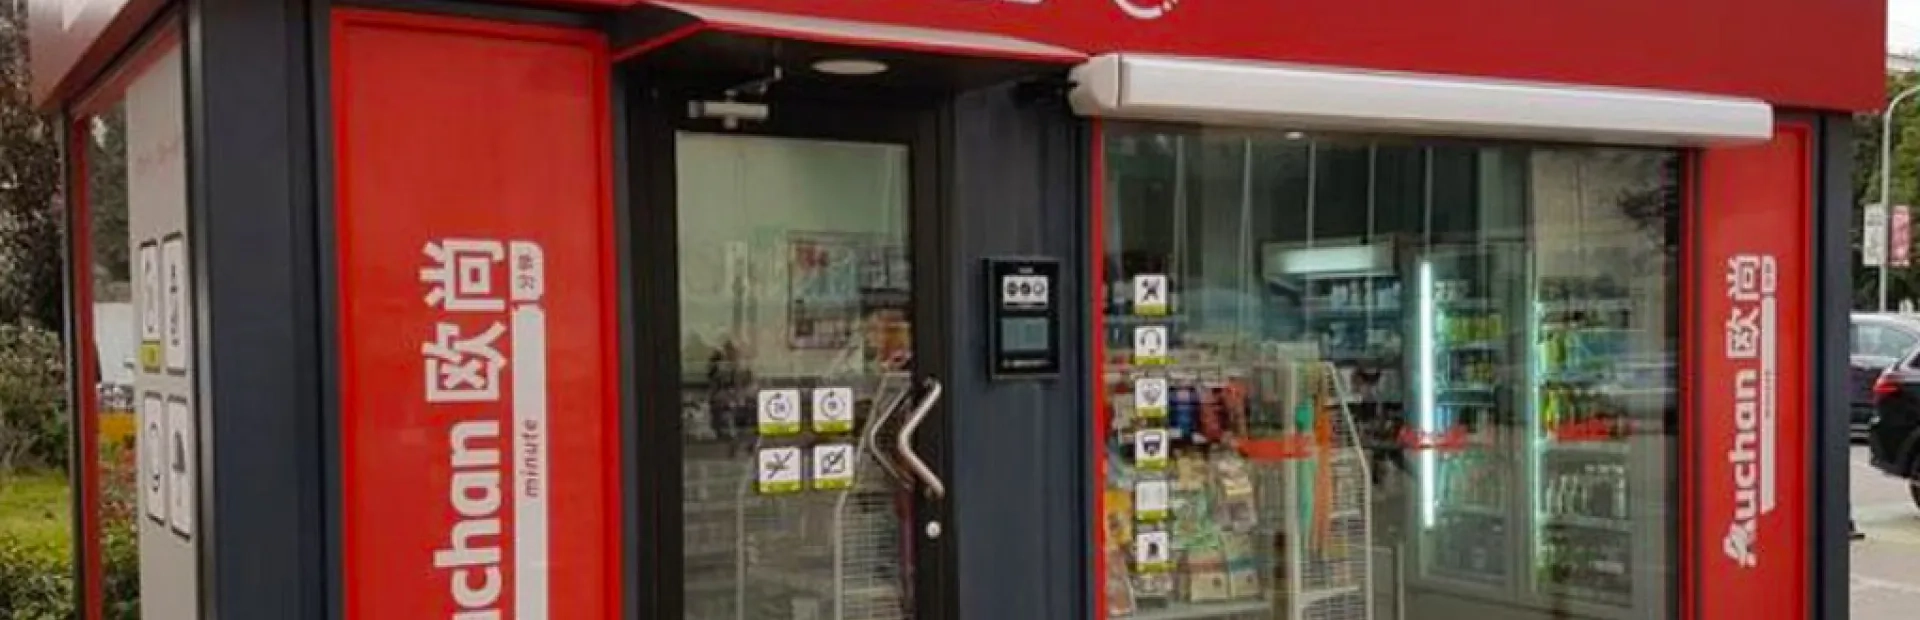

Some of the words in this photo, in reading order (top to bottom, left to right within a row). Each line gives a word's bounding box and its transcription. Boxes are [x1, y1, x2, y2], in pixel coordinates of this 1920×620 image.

[420, 238, 506, 402] 欧尚
[1726, 254, 1761, 359] 欧尚
[432, 420, 502, 620] chan
[521, 418, 540, 499] minute
[1723, 368, 1758, 568] Auchan
